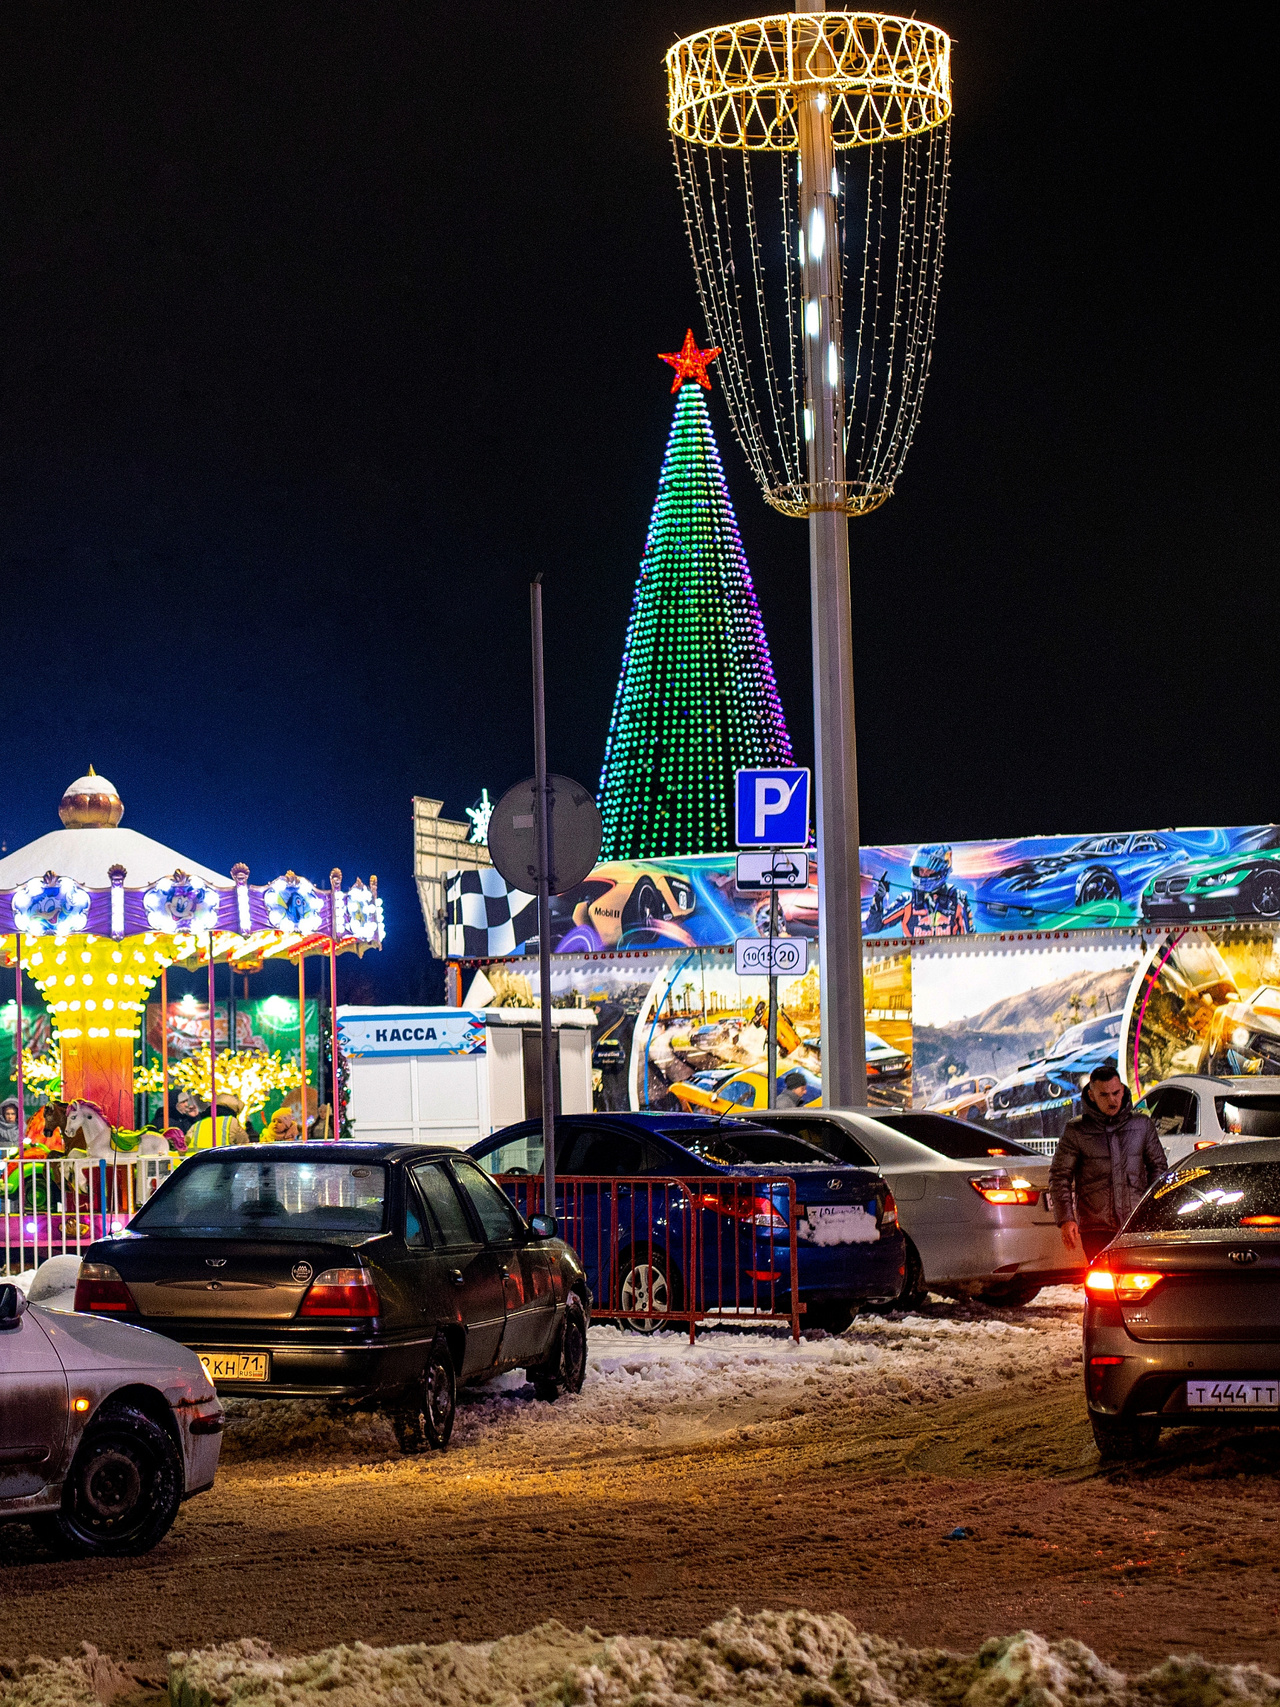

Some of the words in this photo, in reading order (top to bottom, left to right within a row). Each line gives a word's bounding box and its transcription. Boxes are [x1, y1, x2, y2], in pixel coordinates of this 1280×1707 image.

[754, 777, 792, 838] P
[594, 907, 613, 918] Mobil
[746, 952, 757, 961] 10
[779, 950, 795, 963] 20
[375, 1027, 447, 1043] КАССА
[1231, 1251, 1254, 1262] KIA
[241, 1356, 259, 1371] 71
